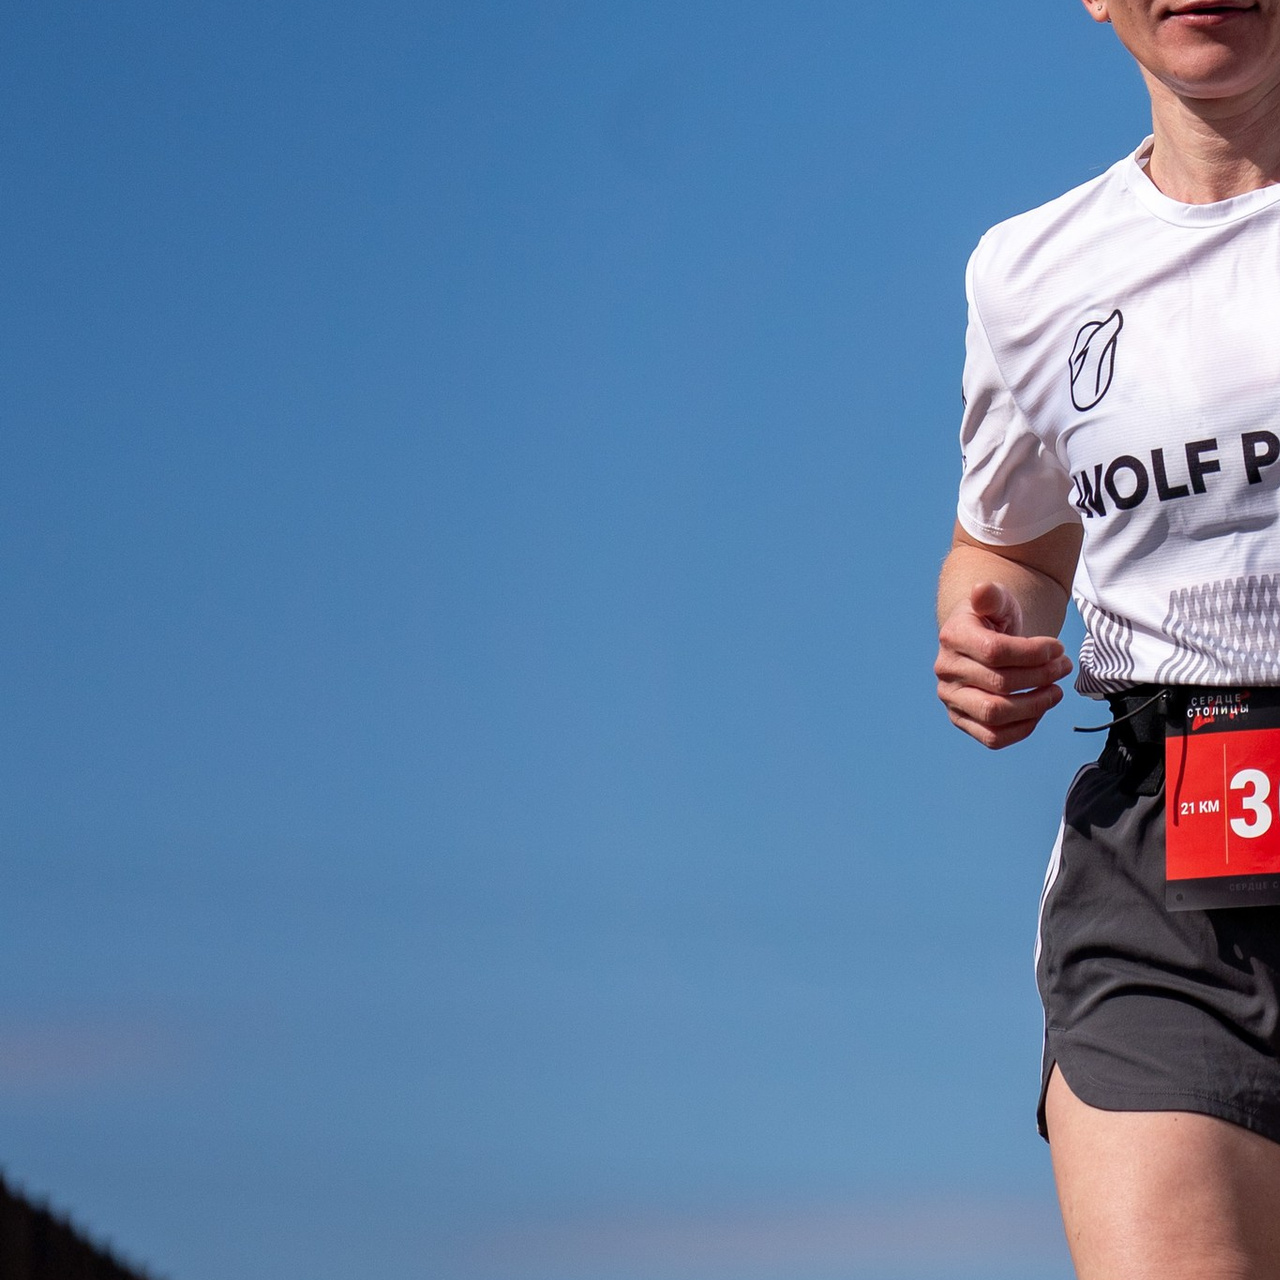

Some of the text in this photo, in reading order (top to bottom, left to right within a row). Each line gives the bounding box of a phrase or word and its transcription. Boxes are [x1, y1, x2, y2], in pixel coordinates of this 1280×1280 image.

[1072, 438, 1221, 519] WOLF
[1191, 694, 1241, 707] СЕРДЦЕ
[1187, 704, 1249, 718] СТОЛИЦЫ
[1180, 802, 1195, 815] 21
[1229, 881, 1268, 892] СЕРДЦЕ
